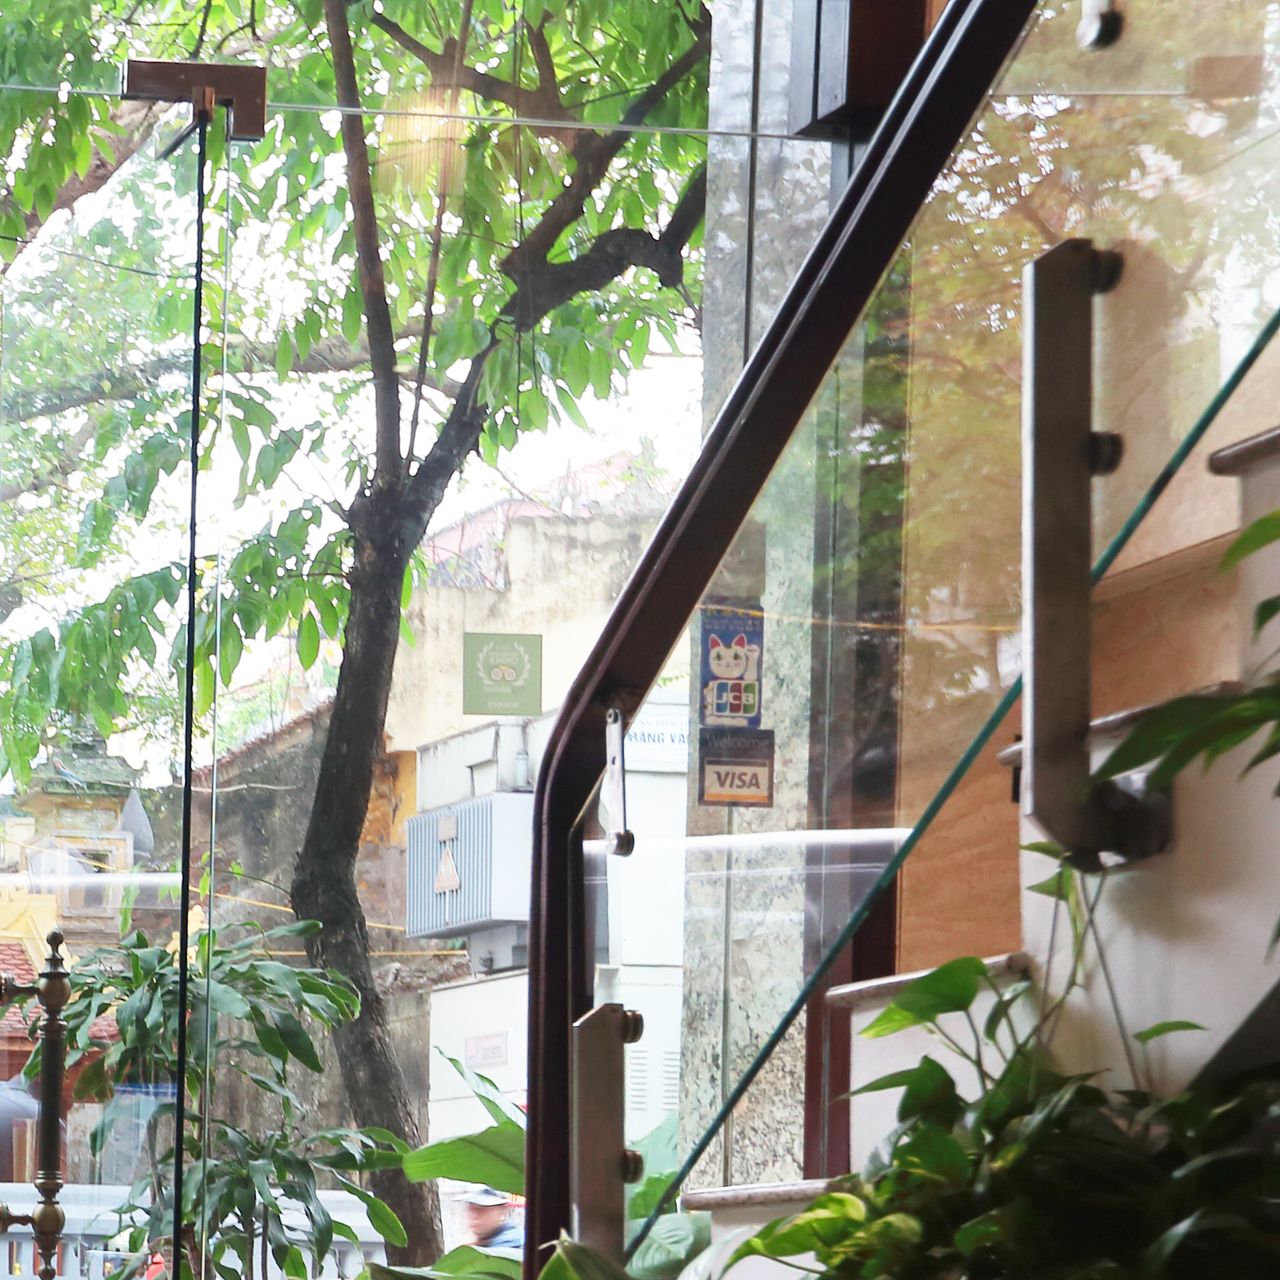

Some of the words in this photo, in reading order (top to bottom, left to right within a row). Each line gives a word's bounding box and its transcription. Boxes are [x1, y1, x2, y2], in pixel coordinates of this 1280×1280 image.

[715, 692, 754, 705] JCB
[706, 734, 769, 749] Welcome
[714, 770, 760, 789] VISA
